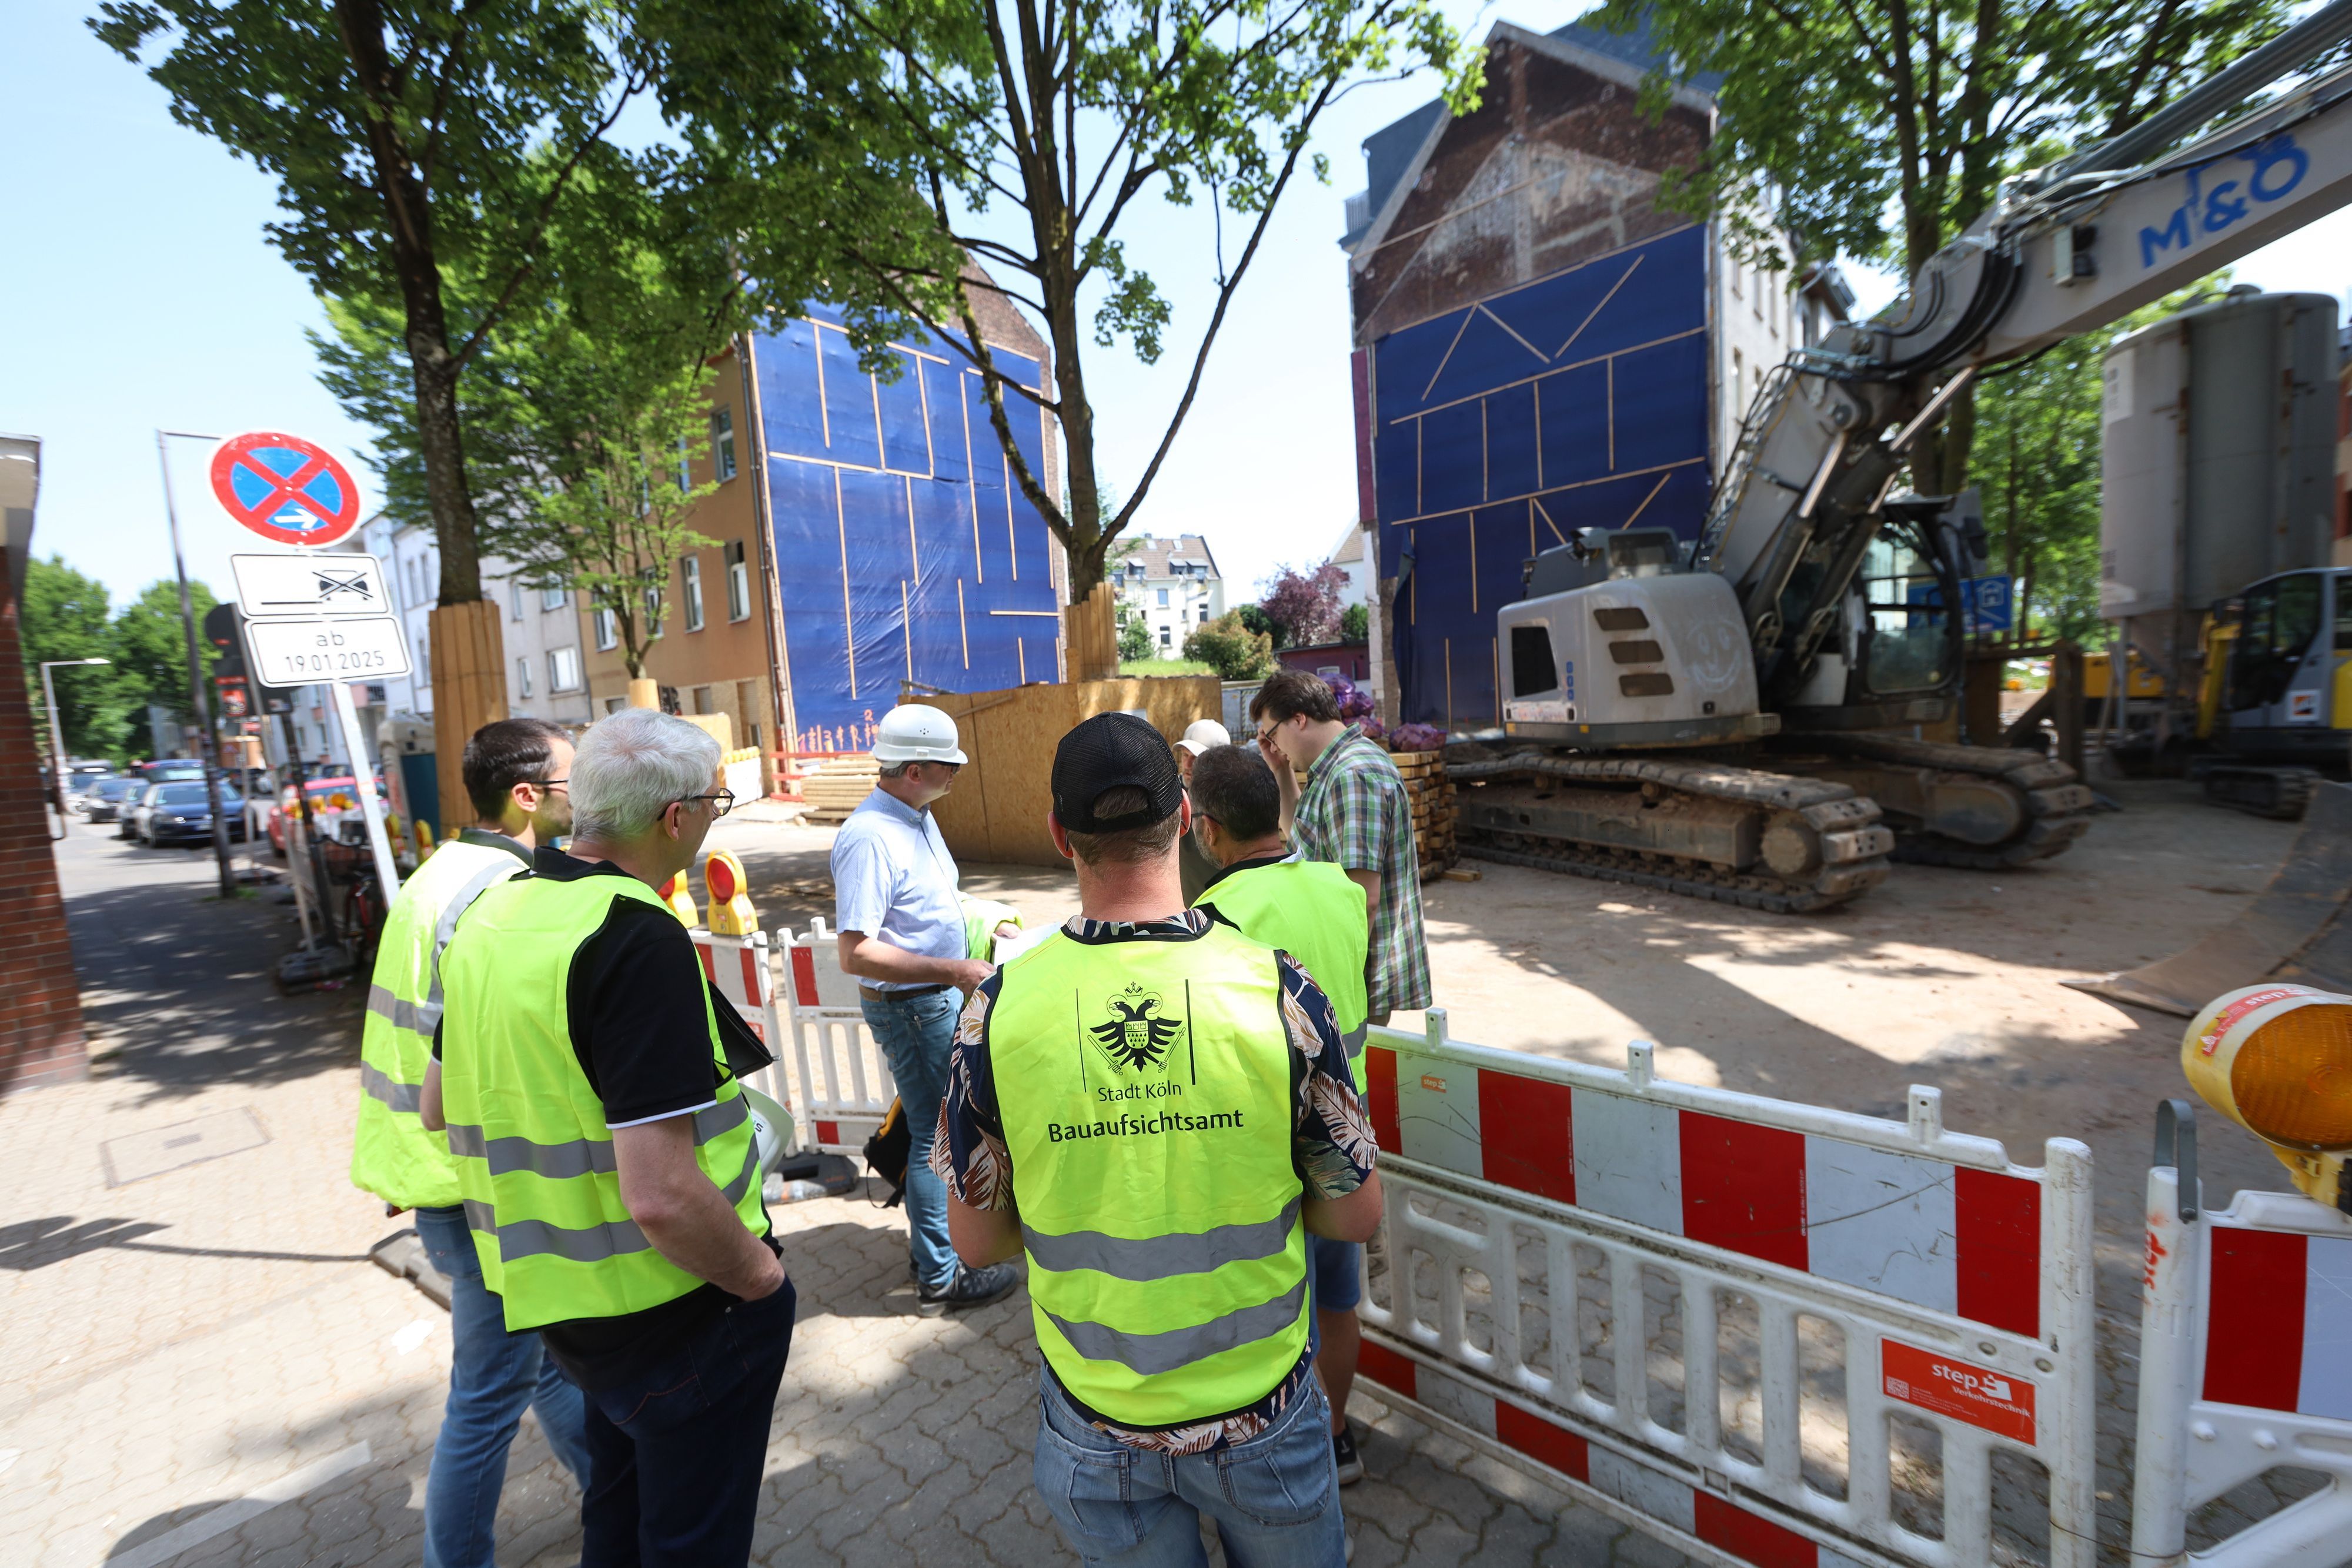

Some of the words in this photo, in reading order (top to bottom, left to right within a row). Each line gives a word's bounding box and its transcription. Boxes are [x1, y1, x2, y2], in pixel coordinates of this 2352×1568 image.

[2139, 146, 2310, 269] M&O
[316, 630, 345, 647] ab
[285, 650, 385, 673] 19.01.2025
[2245, 991, 2286, 1006] step
[1098, 1083, 1141, 1102] Stadt
[1145, 1079, 1182, 1099] Köln
[1424, 1078, 1437, 1088] step
[1048, 1109, 1244, 1142] Bauaufsichtsamt
[1932, 1363, 1979, 1390] step
[1952, 1385, 2031, 1417] Verkehrstechnik
